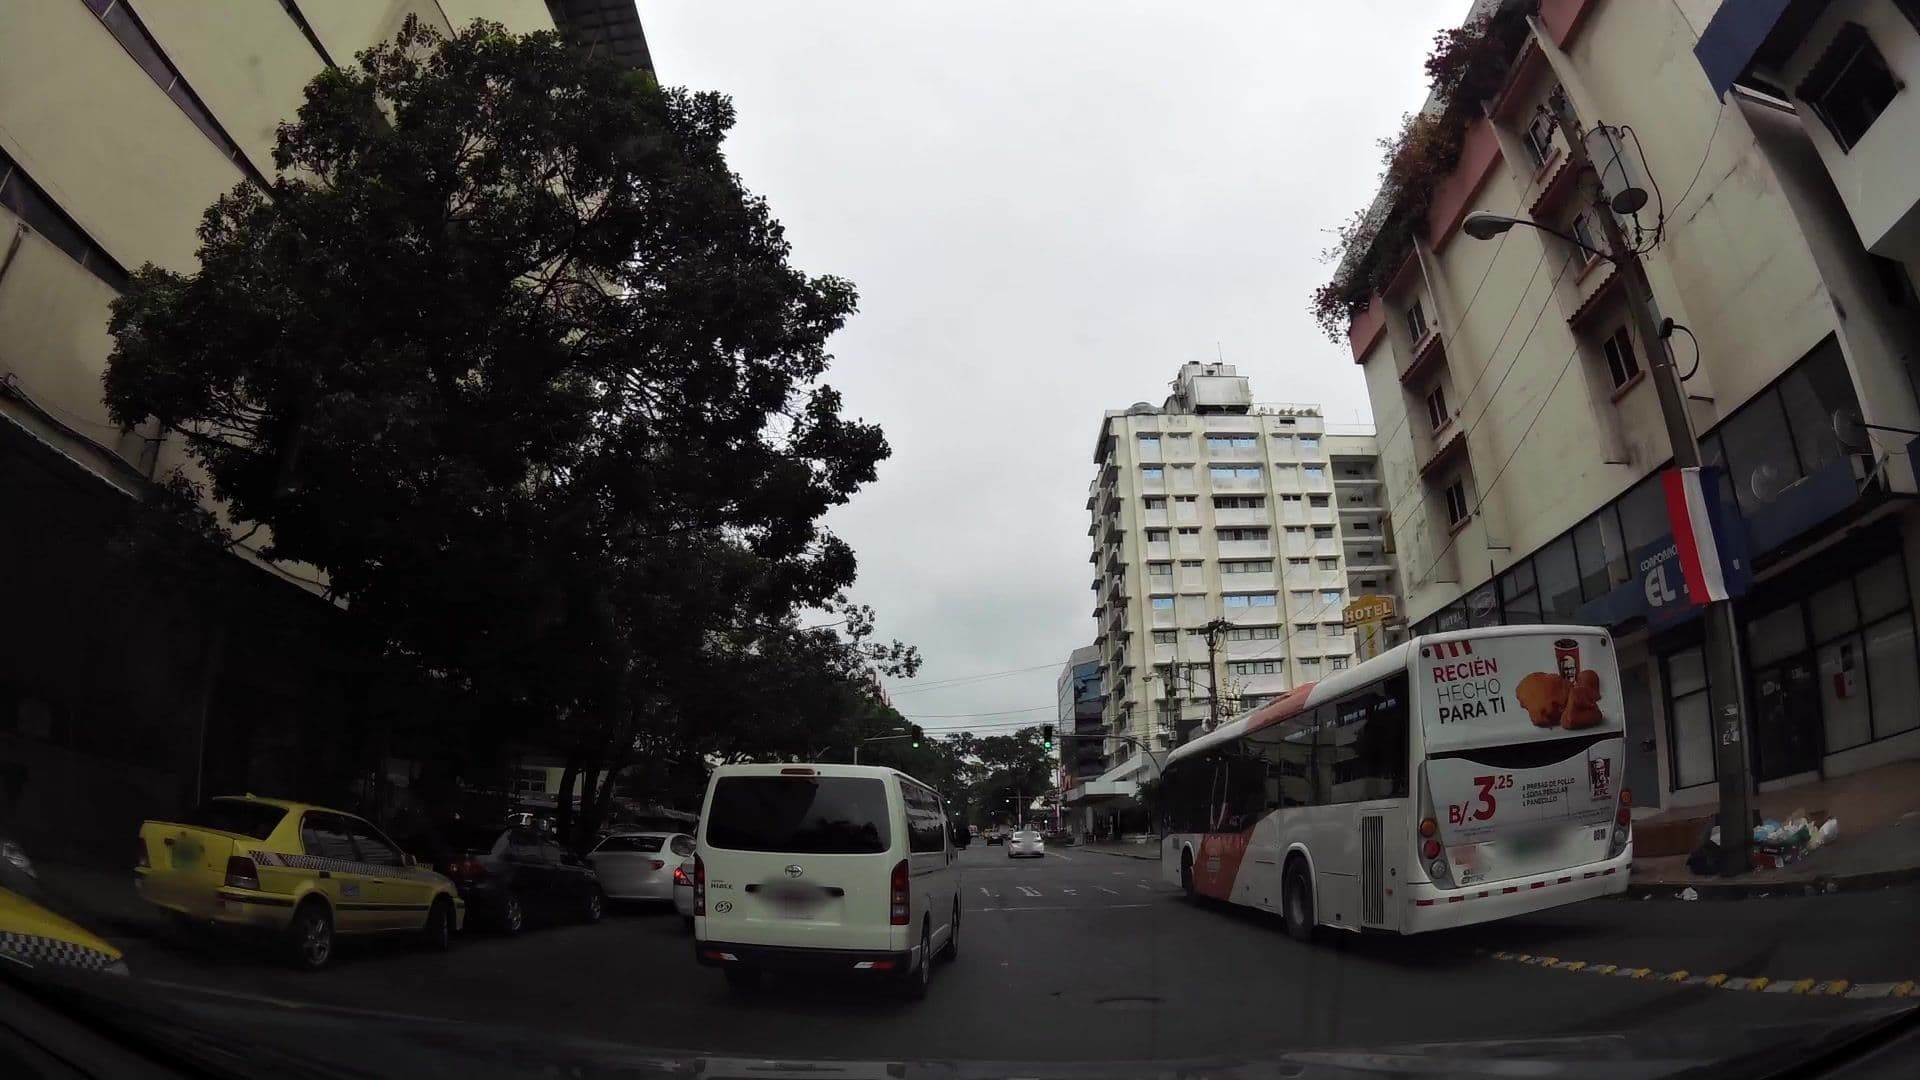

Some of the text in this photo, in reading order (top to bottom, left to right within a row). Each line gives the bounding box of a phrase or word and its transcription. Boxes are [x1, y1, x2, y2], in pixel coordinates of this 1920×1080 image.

[1645, 564, 1676, 607] EL
[1344, 603, 1392, 623] HOTEL
[1432, 656, 1498, 683] RECIÉN
[1436, 678, 1501, 704] HECHO
[1439, 696, 1506, 724] PARA TI
[1557, 777, 1576, 786] POLLO
[1593, 787, 1609, 796] KFC
